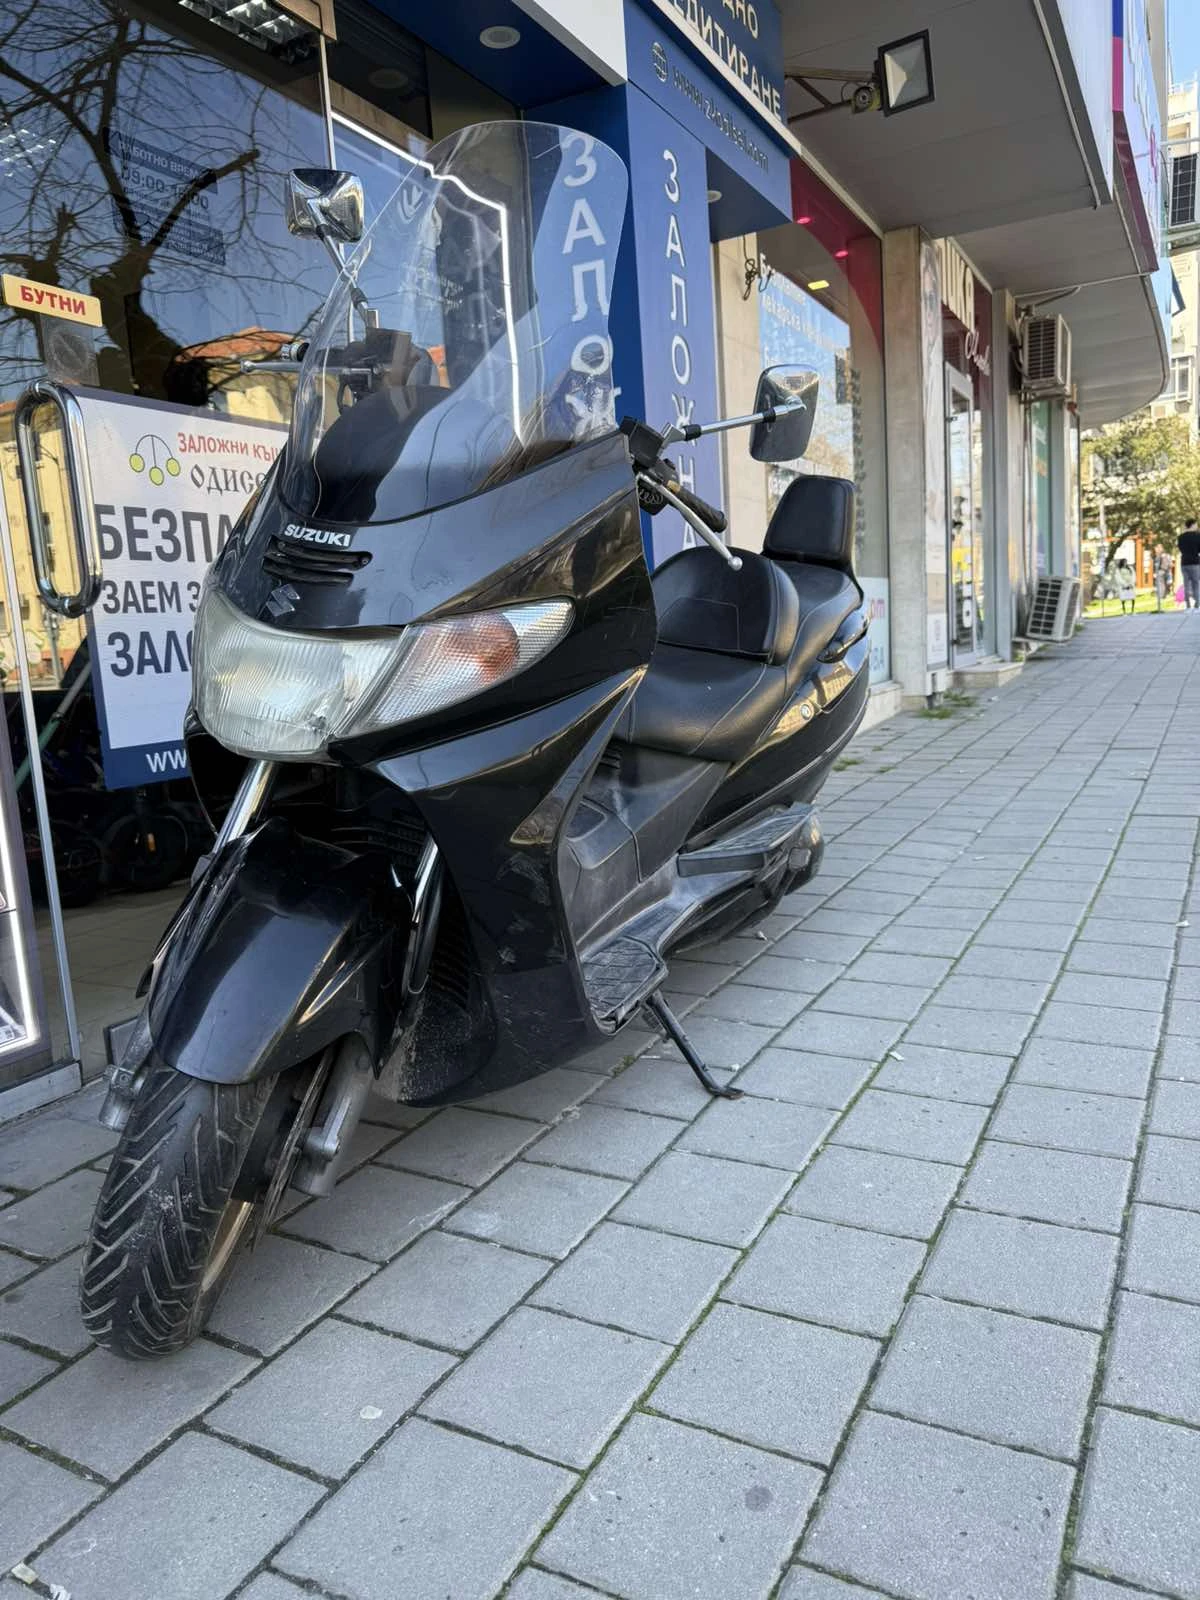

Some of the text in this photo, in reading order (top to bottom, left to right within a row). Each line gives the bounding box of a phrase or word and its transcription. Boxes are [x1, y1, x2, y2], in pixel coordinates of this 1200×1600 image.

[20, 285, 86, 315] БУТНИ
[178, 432, 249, 456] ЗАЛОЖНИ
[284, 524, 351, 547] SUZUKI
[102, 579, 182, 614] ЗАЕМ
[107, 630, 193, 677] ЗАЛ
